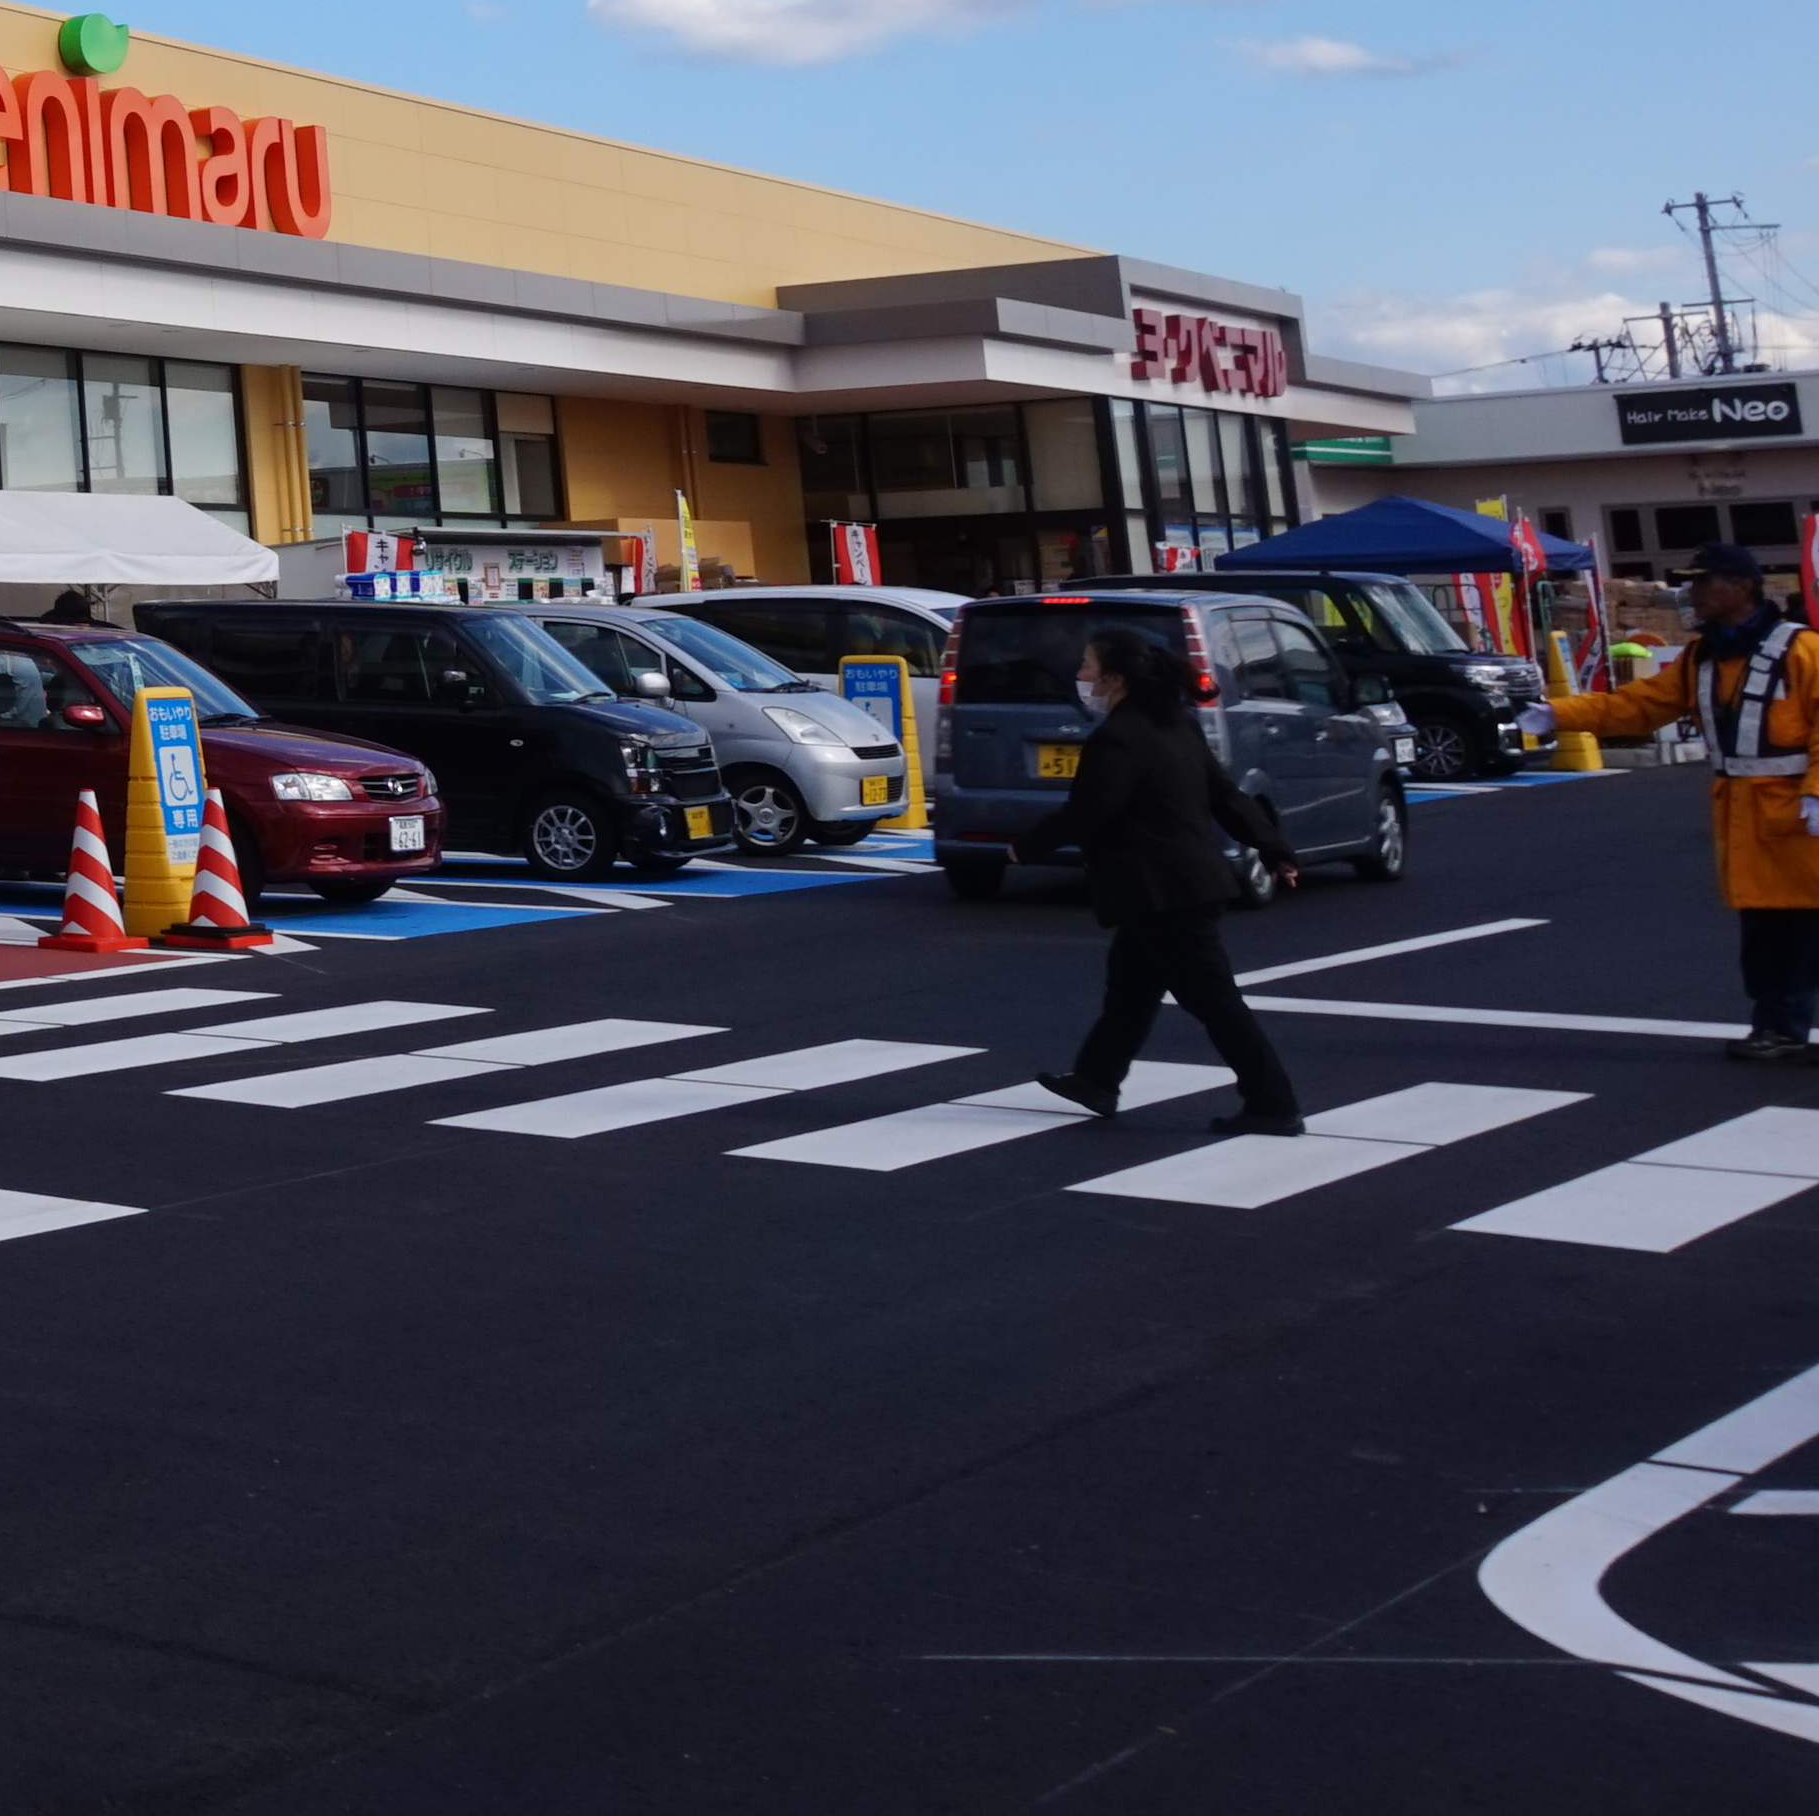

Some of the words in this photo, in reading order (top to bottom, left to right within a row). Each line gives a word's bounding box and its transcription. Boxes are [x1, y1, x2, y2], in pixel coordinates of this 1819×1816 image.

[1131, 308, 1287, 397] ヨークベニマル
[1627, 411, 1662, 424] Hair
[1667, 408, 1708, 422] Make
[1712, 398, 1789, 423] Neo
[425, 549, 472, 574] リサイクル
[507, 549, 558, 573] ステーション
[149, 706, 192, 721] おもいやり
[158, 724, 188, 741] 駐車場
[171, 809, 199, 829] 専用
